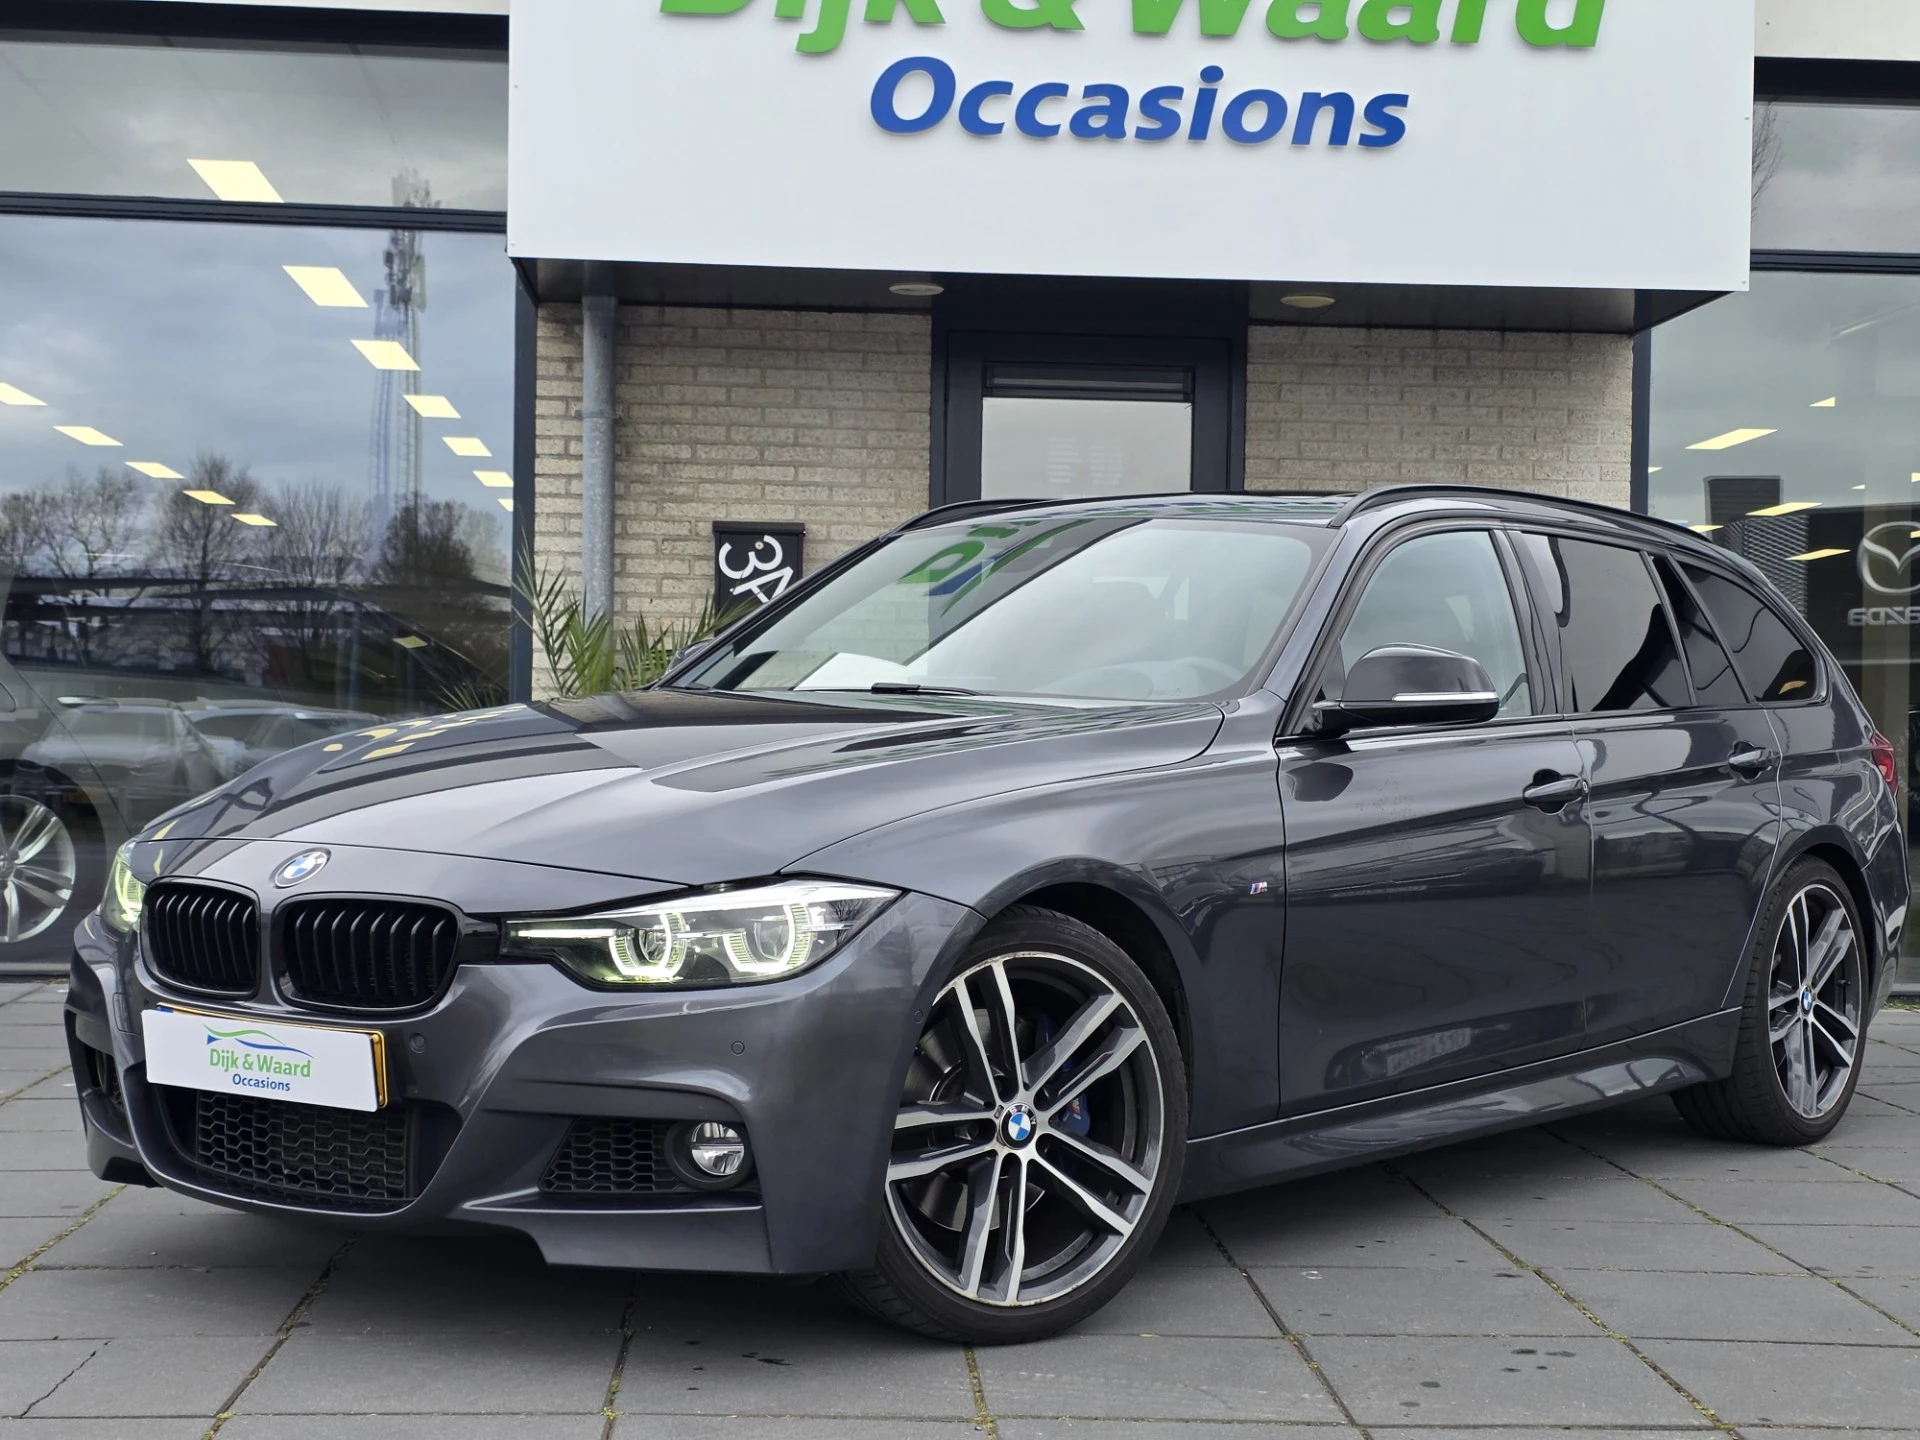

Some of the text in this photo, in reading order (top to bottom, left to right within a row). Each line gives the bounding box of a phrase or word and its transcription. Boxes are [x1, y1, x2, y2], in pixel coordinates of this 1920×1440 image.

[1131, 0, 1605, 48] aar
[870, 56, 1409, 148] Occasions
[209, 1048, 311, 1077] Dijk & Waard
[232, 1073, 291, 1091] Occasions
